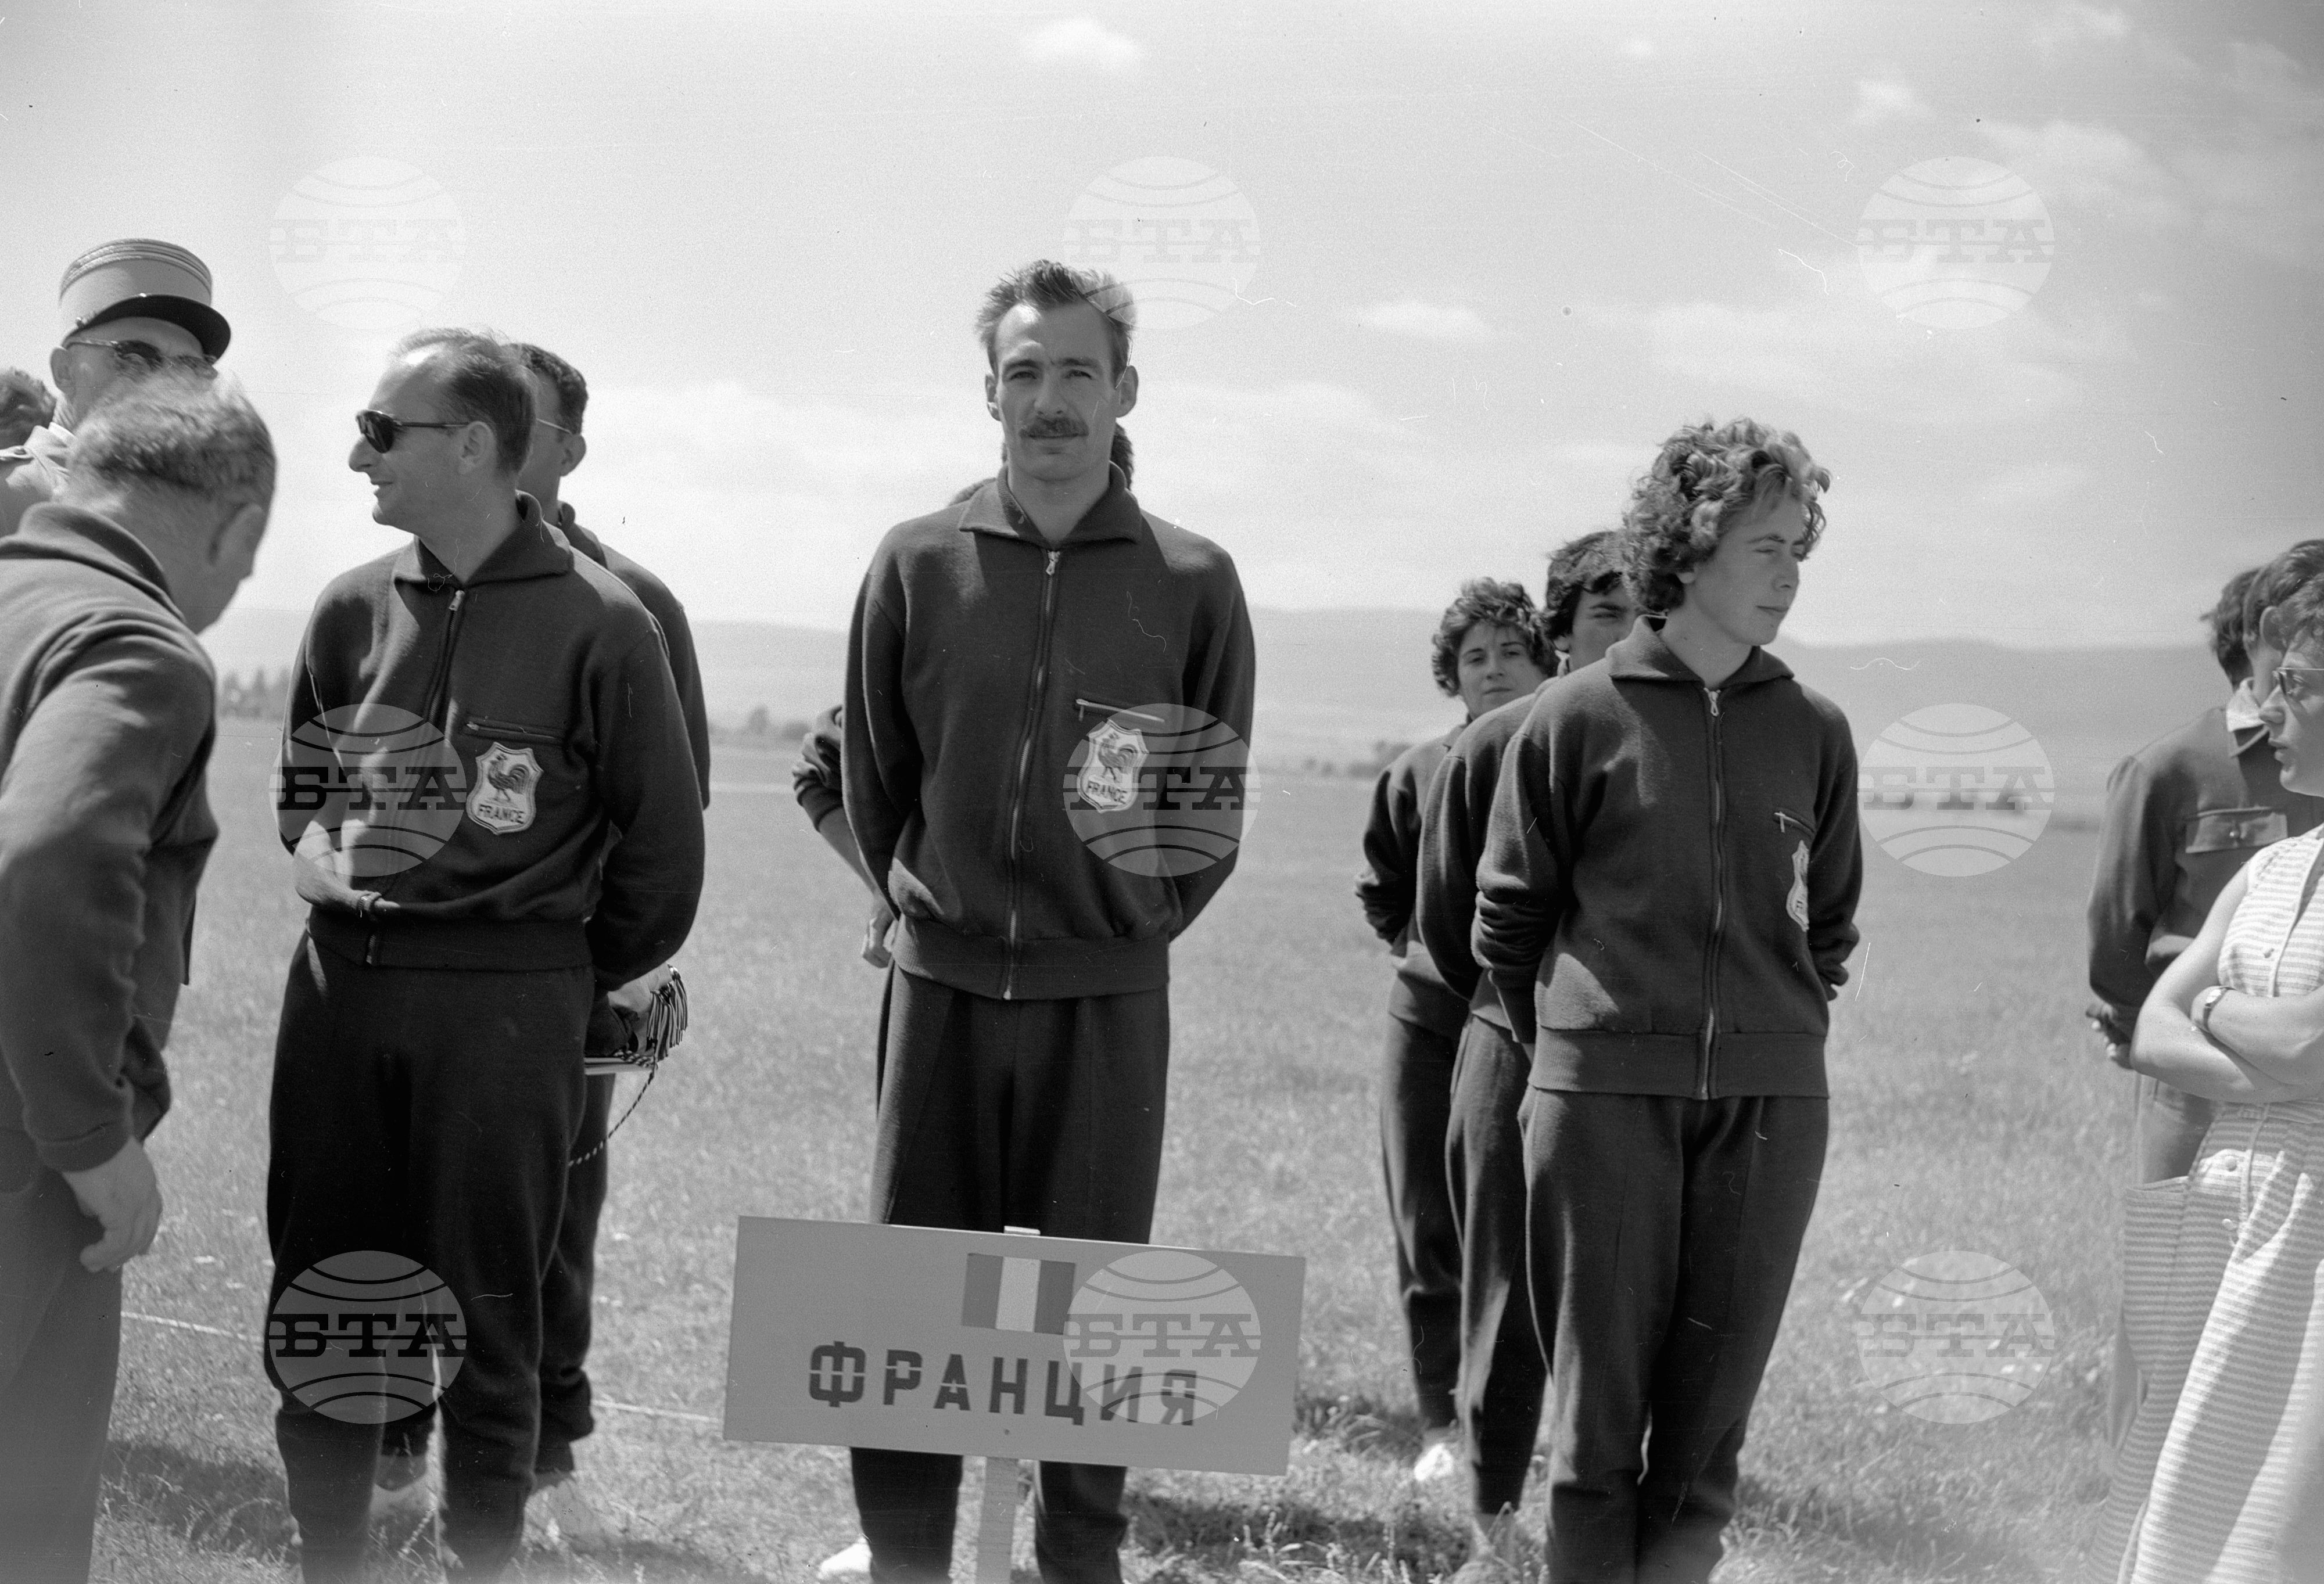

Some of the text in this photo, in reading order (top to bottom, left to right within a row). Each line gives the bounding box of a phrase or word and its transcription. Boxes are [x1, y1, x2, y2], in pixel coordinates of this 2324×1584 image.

[1086, 780, 1128, 804] FRANCE
[478, 804, 525, 824] FRANCE
[808, 1340, 1197, 1426] ФРАНЦИЯ
